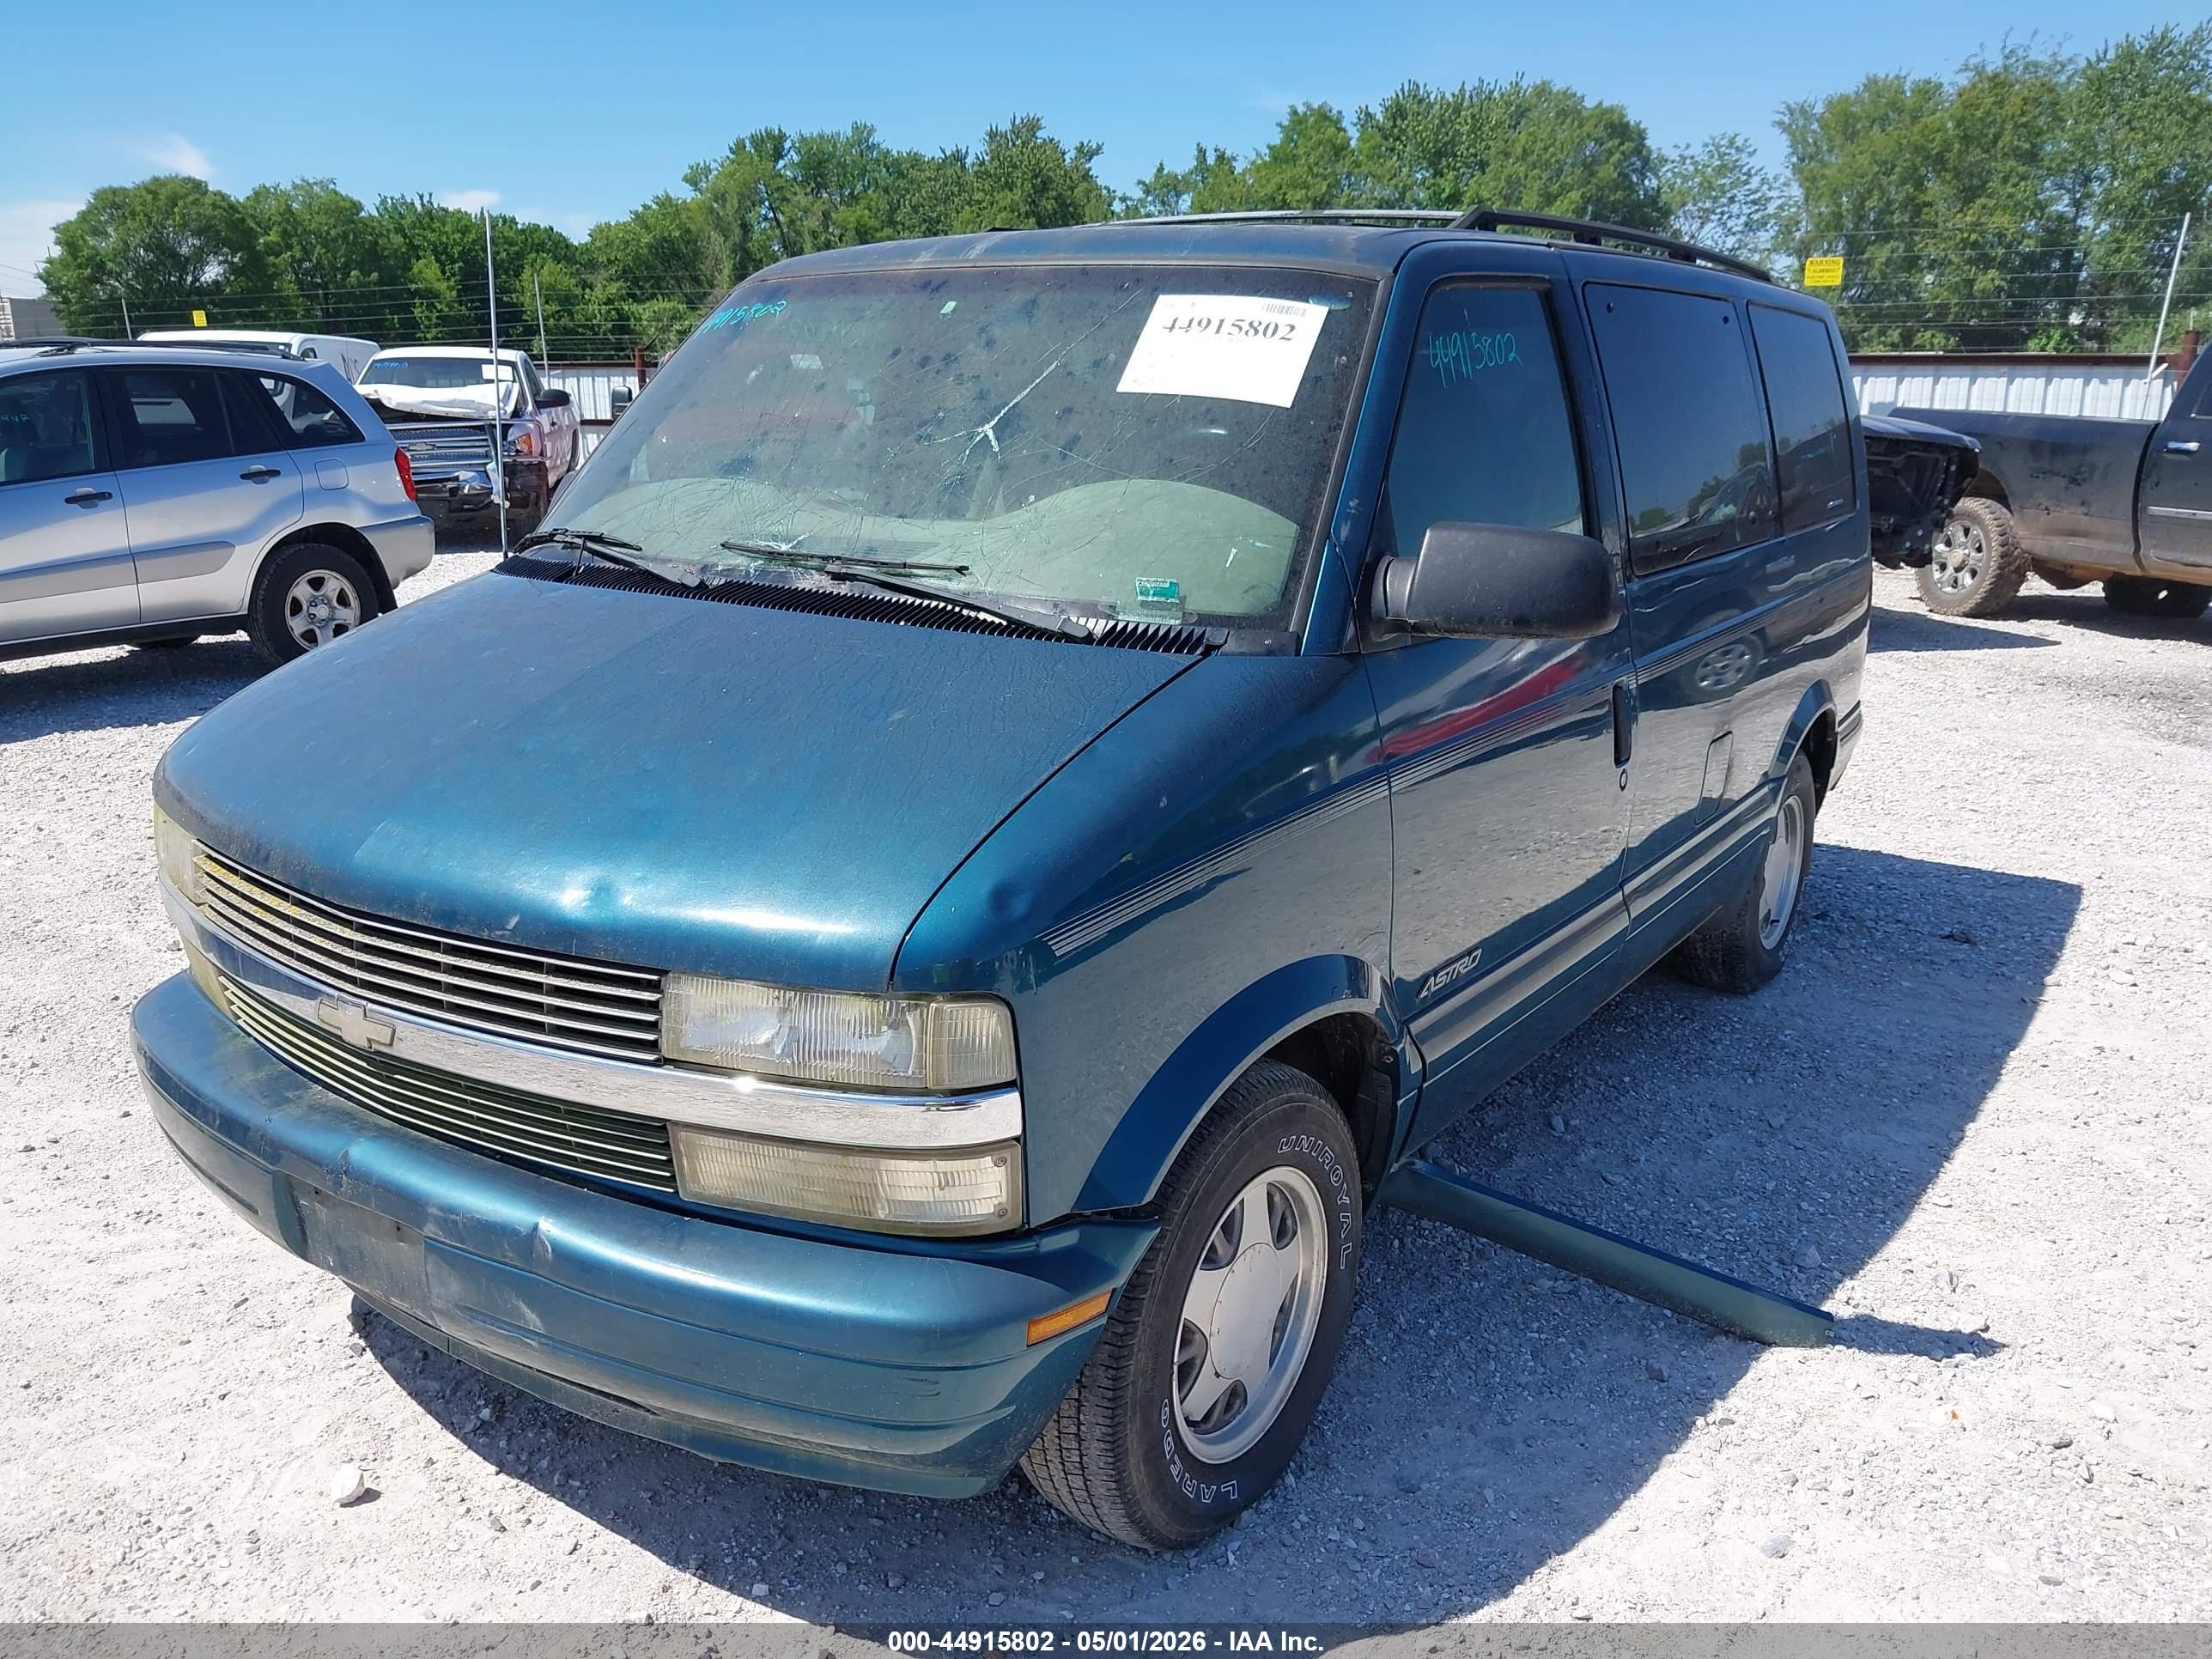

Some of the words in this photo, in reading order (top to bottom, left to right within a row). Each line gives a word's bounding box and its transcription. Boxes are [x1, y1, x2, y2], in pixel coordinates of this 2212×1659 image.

[1162, 315, 1297, 343] 44915802
[1418, 948, 1483, 1000] ASTRO
[1277, 1134, 1352, 1270] UNIROYAL
[1161, 1398, 1238, 1503] LAREDO
